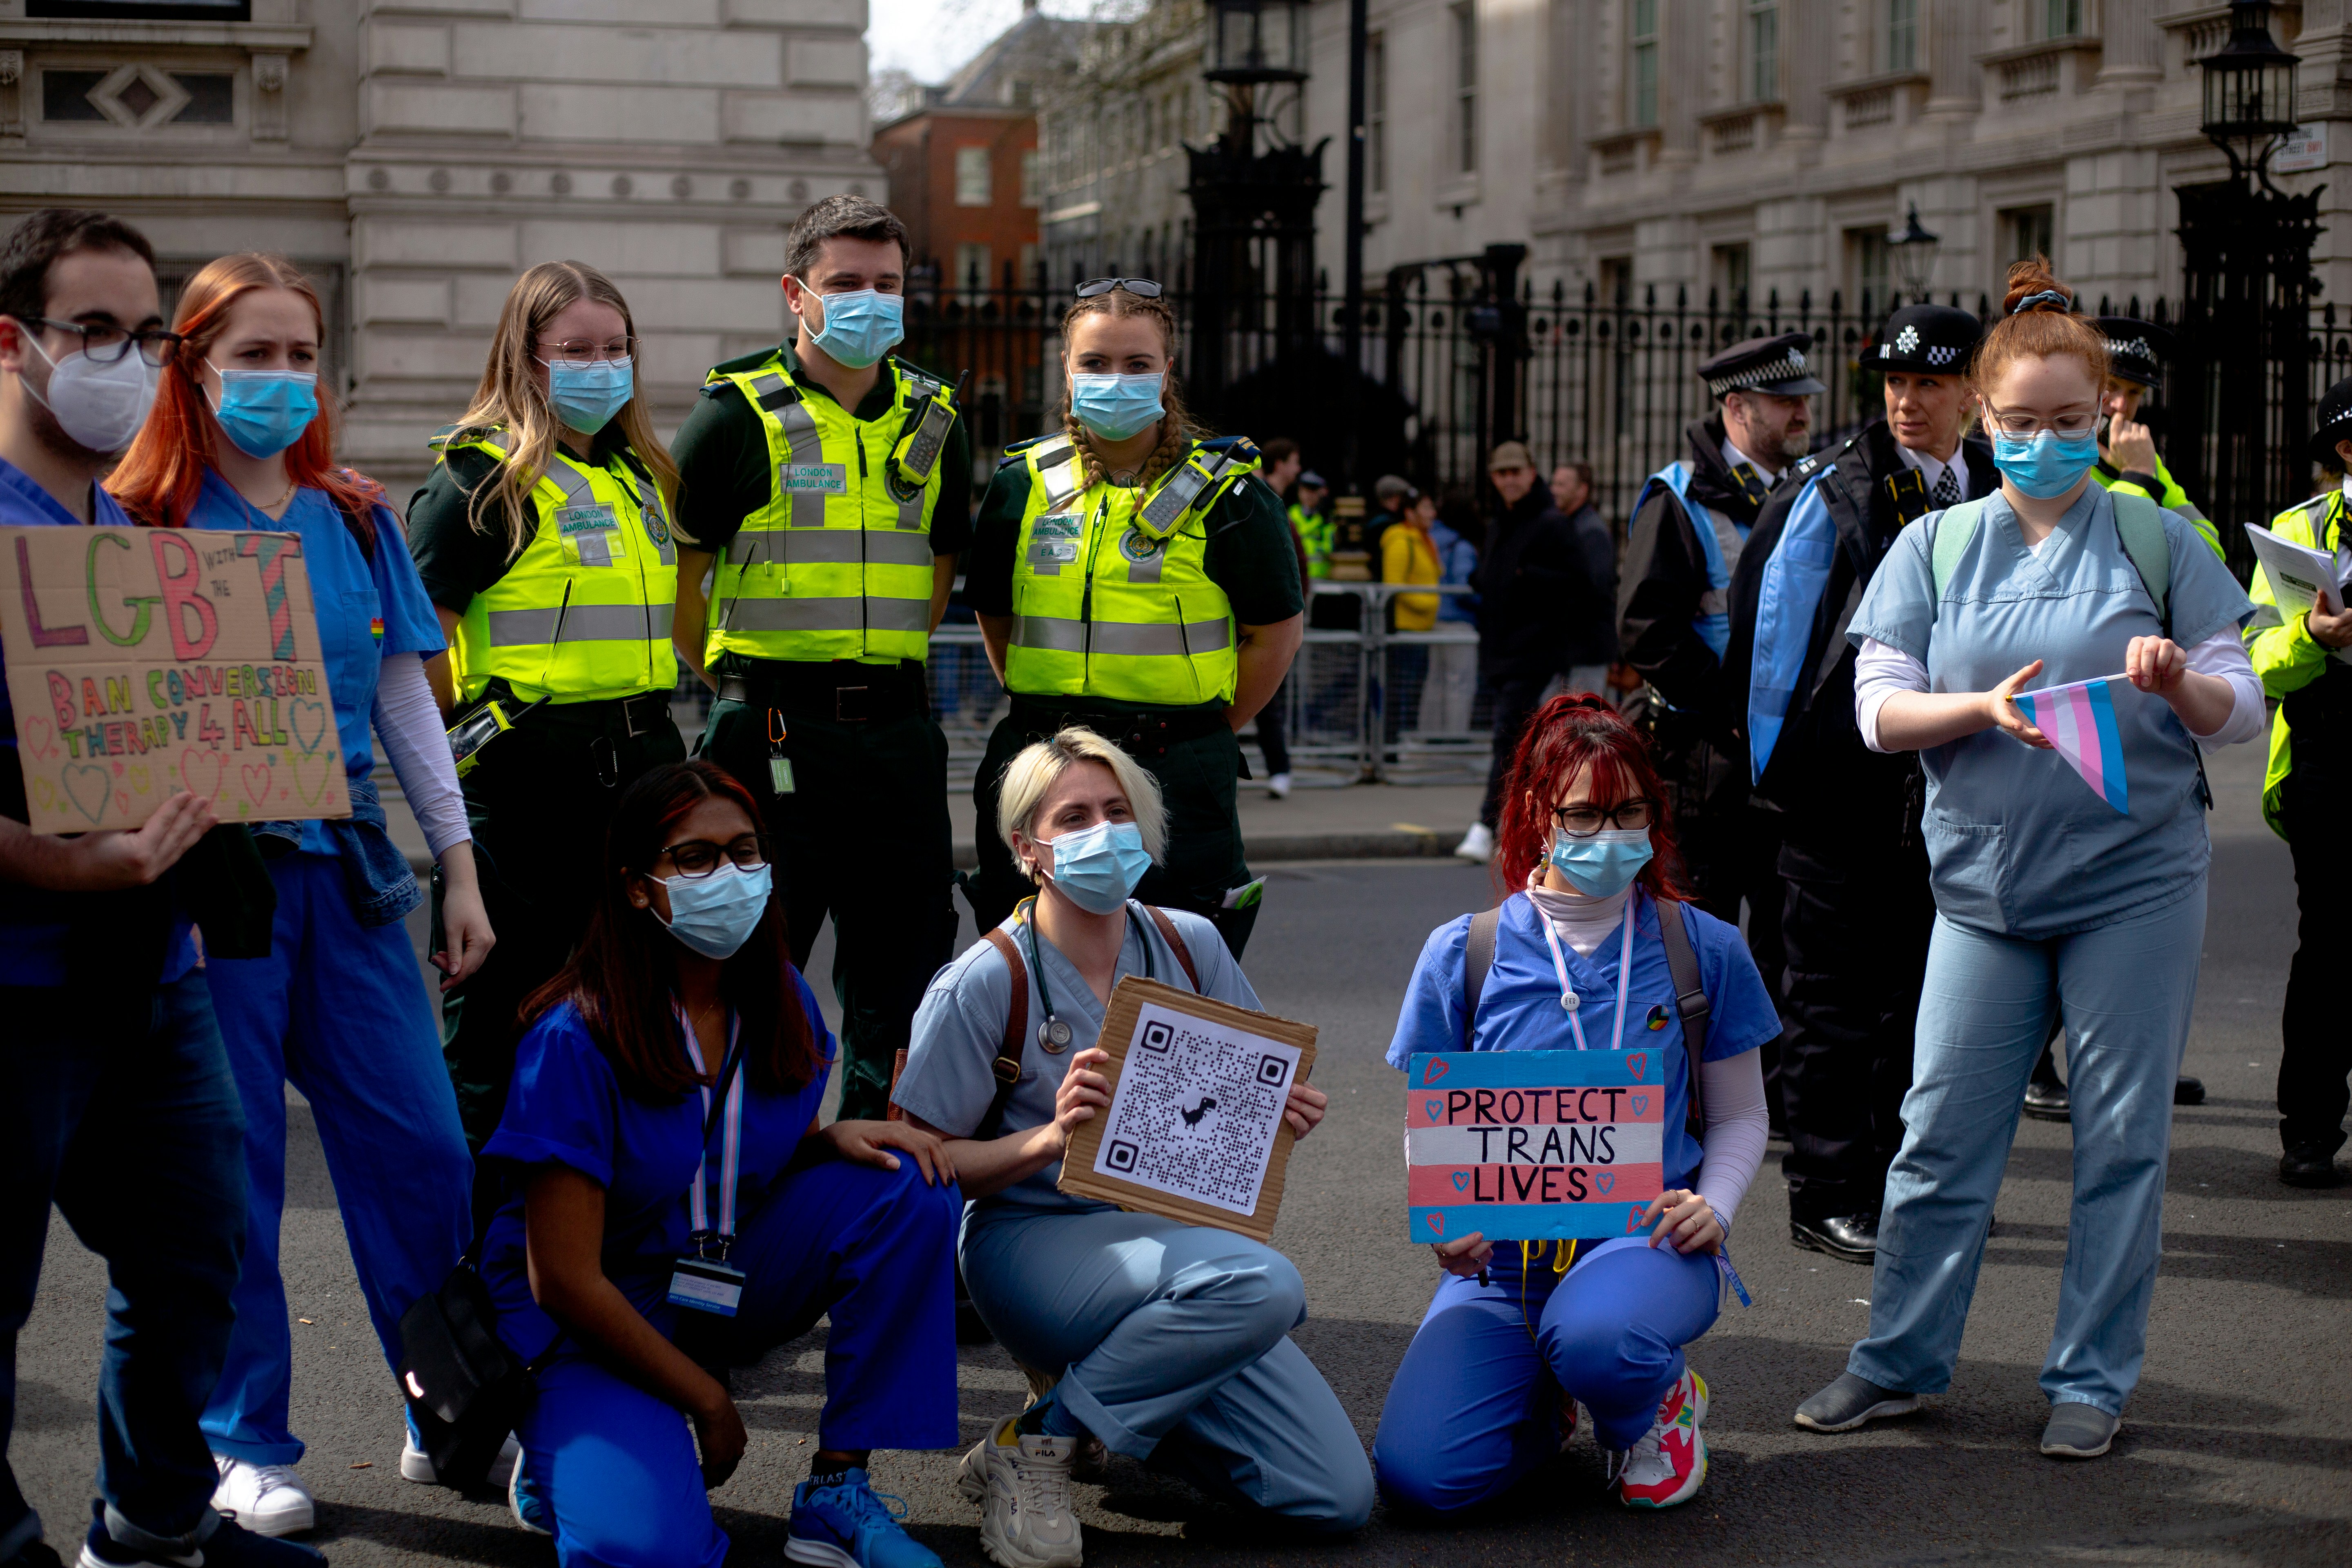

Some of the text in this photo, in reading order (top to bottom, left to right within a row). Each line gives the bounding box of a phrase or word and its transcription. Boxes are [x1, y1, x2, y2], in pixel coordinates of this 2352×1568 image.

[795, 468, 832, 477] LONDON
[787, 479, 841, 488] AMBULANCE
[569, 510, 604, 521] LONDON
[1042, 518, 1074, 526] LONDON
[563, 518, 615, 533] AMBULANCE
[1033, 527, 1078, 536] AMBULANCE
[203, 549, 236, 571] WITH
[210, 579, 231, 597] THE
[47, 665, 316, 731] BAN CONVERSION
[61, 697, 288, 758] THERAPY 4 ALL
[1448, 1088, 1626, 1125] PROTECT
[1467, 1126, 1616, 1165] TRANS
[1474, 1166, 1588, 1202] LIVES
